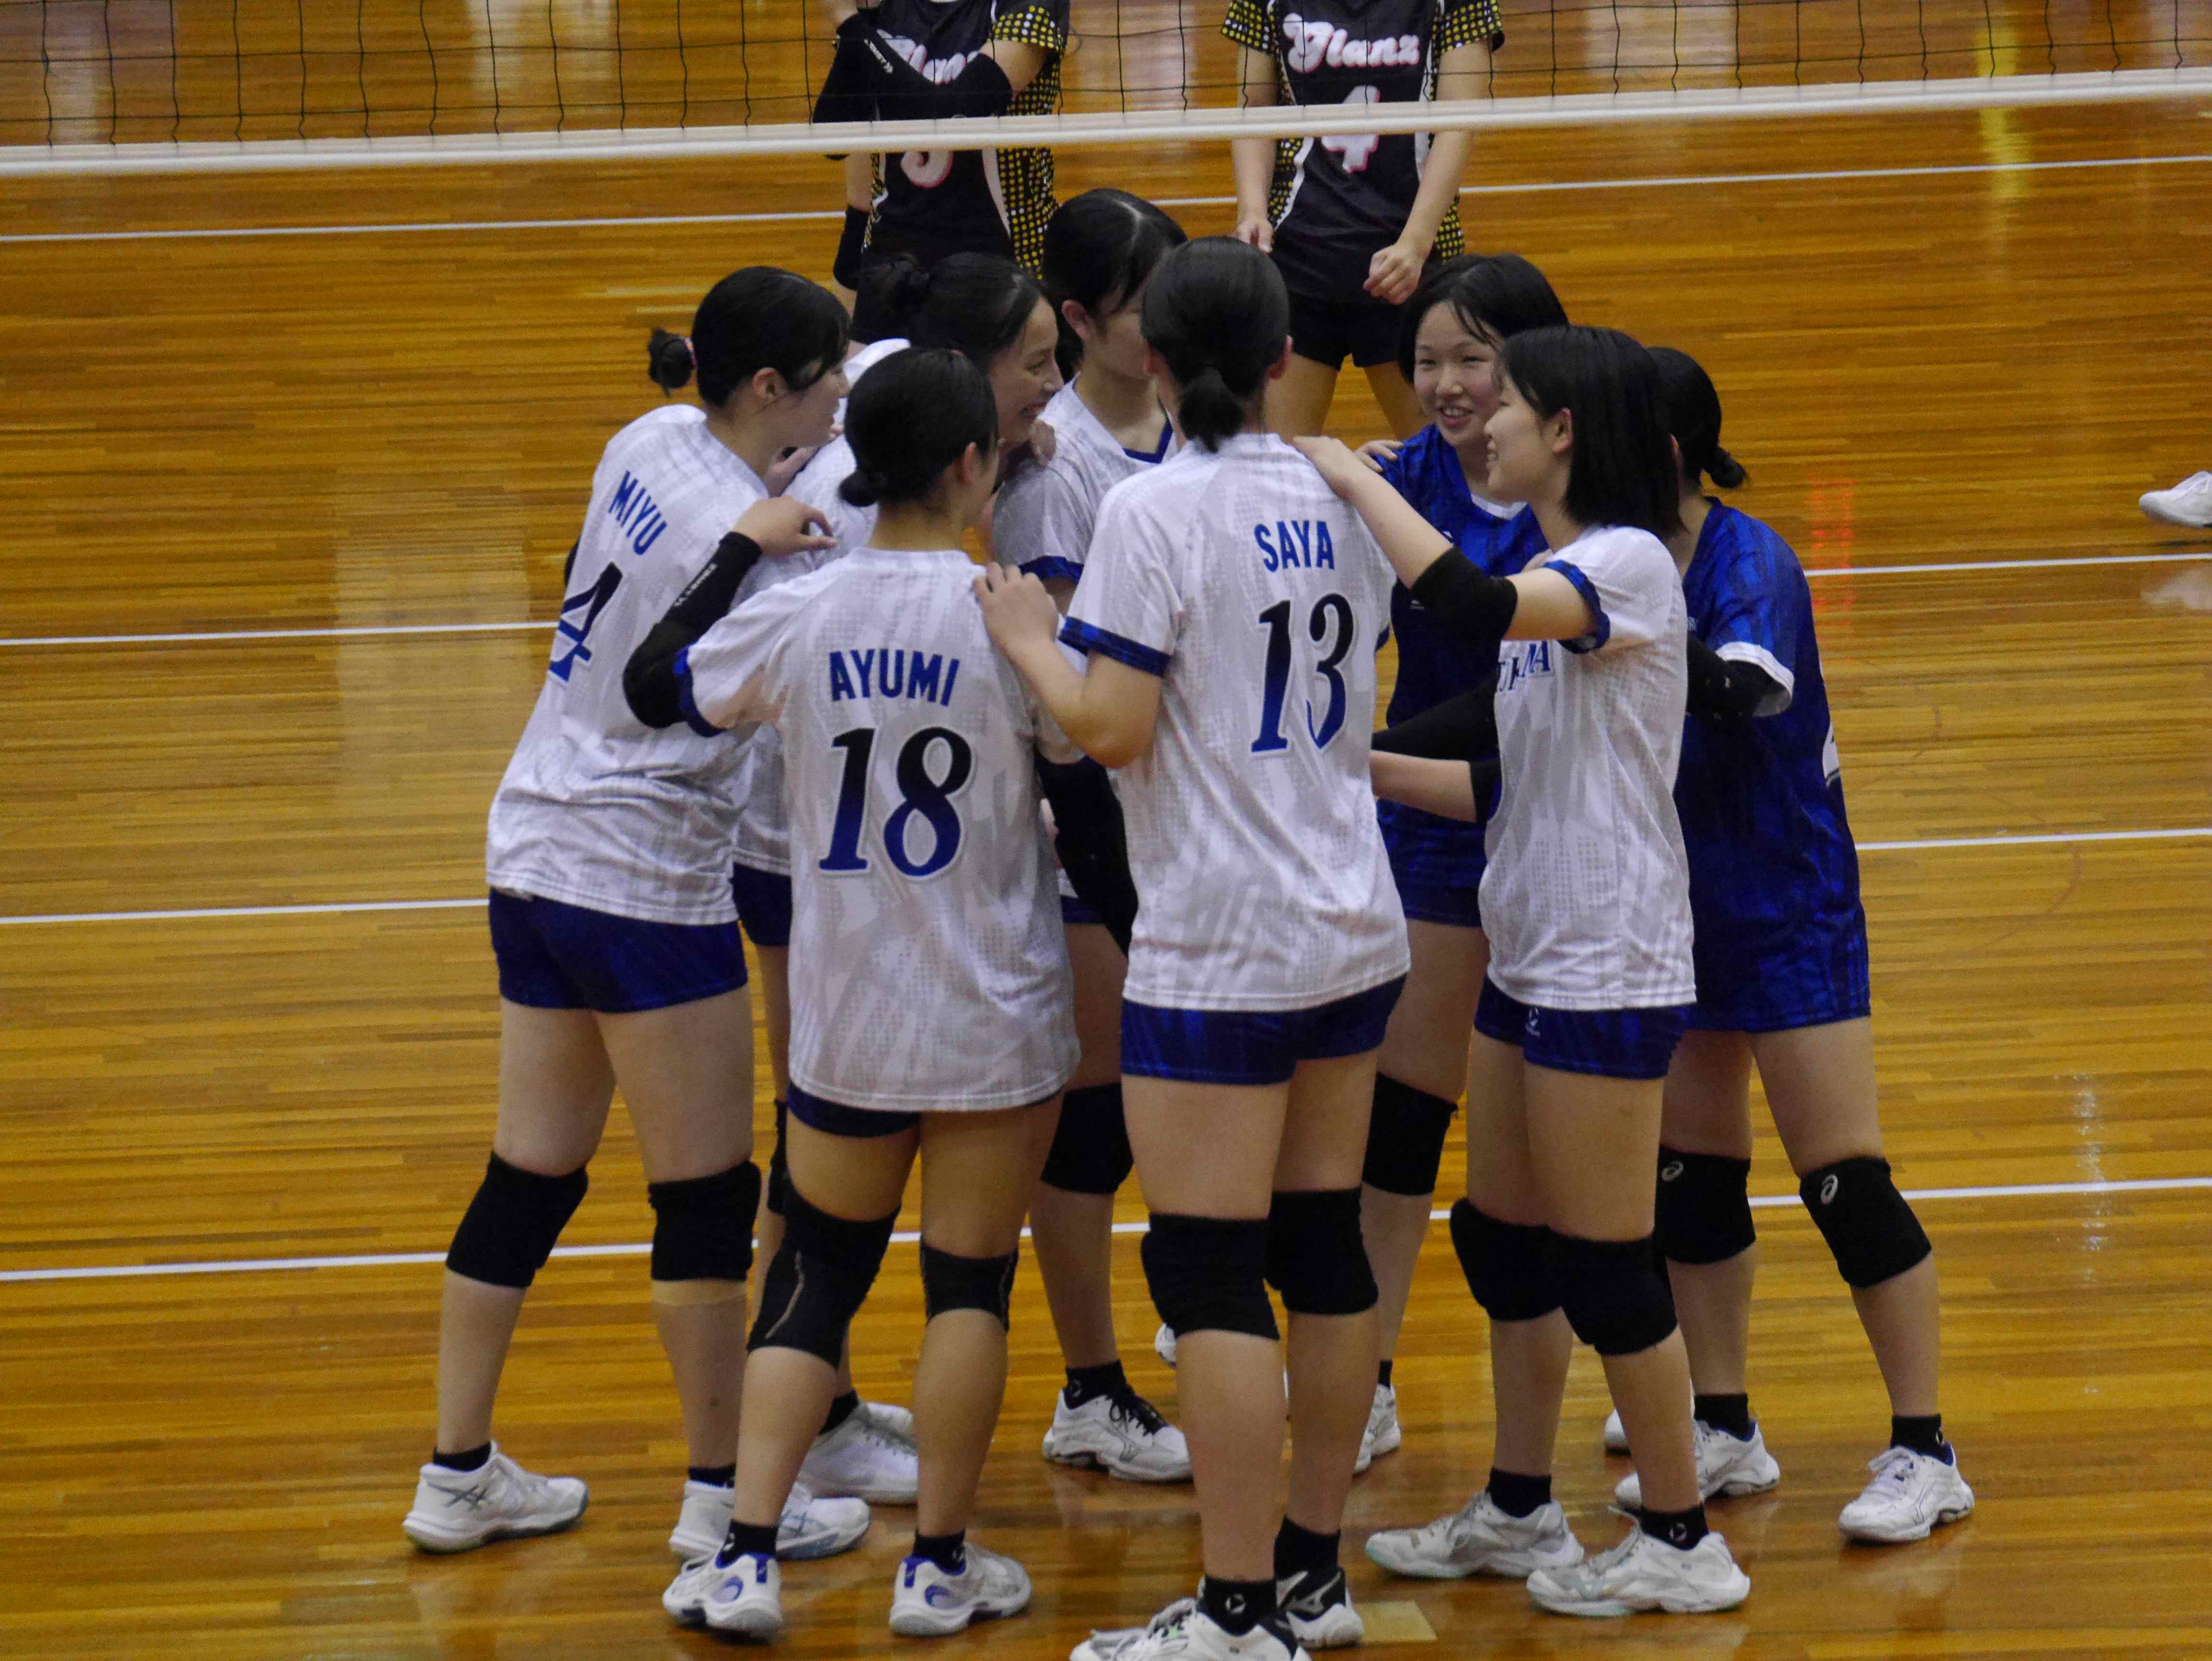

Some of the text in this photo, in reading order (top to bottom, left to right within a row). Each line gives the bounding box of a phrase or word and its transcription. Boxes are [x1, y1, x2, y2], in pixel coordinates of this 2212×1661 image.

[608, 470, 668, 555] MIYU
[1254, 520, 1335, 572] SAYA
[549, 562, 623, 683] 4
[1251, 593, 1354, 753] 13
[829, 648, 960, 707] AYUMI
[819, 726, 972, 877] 18
